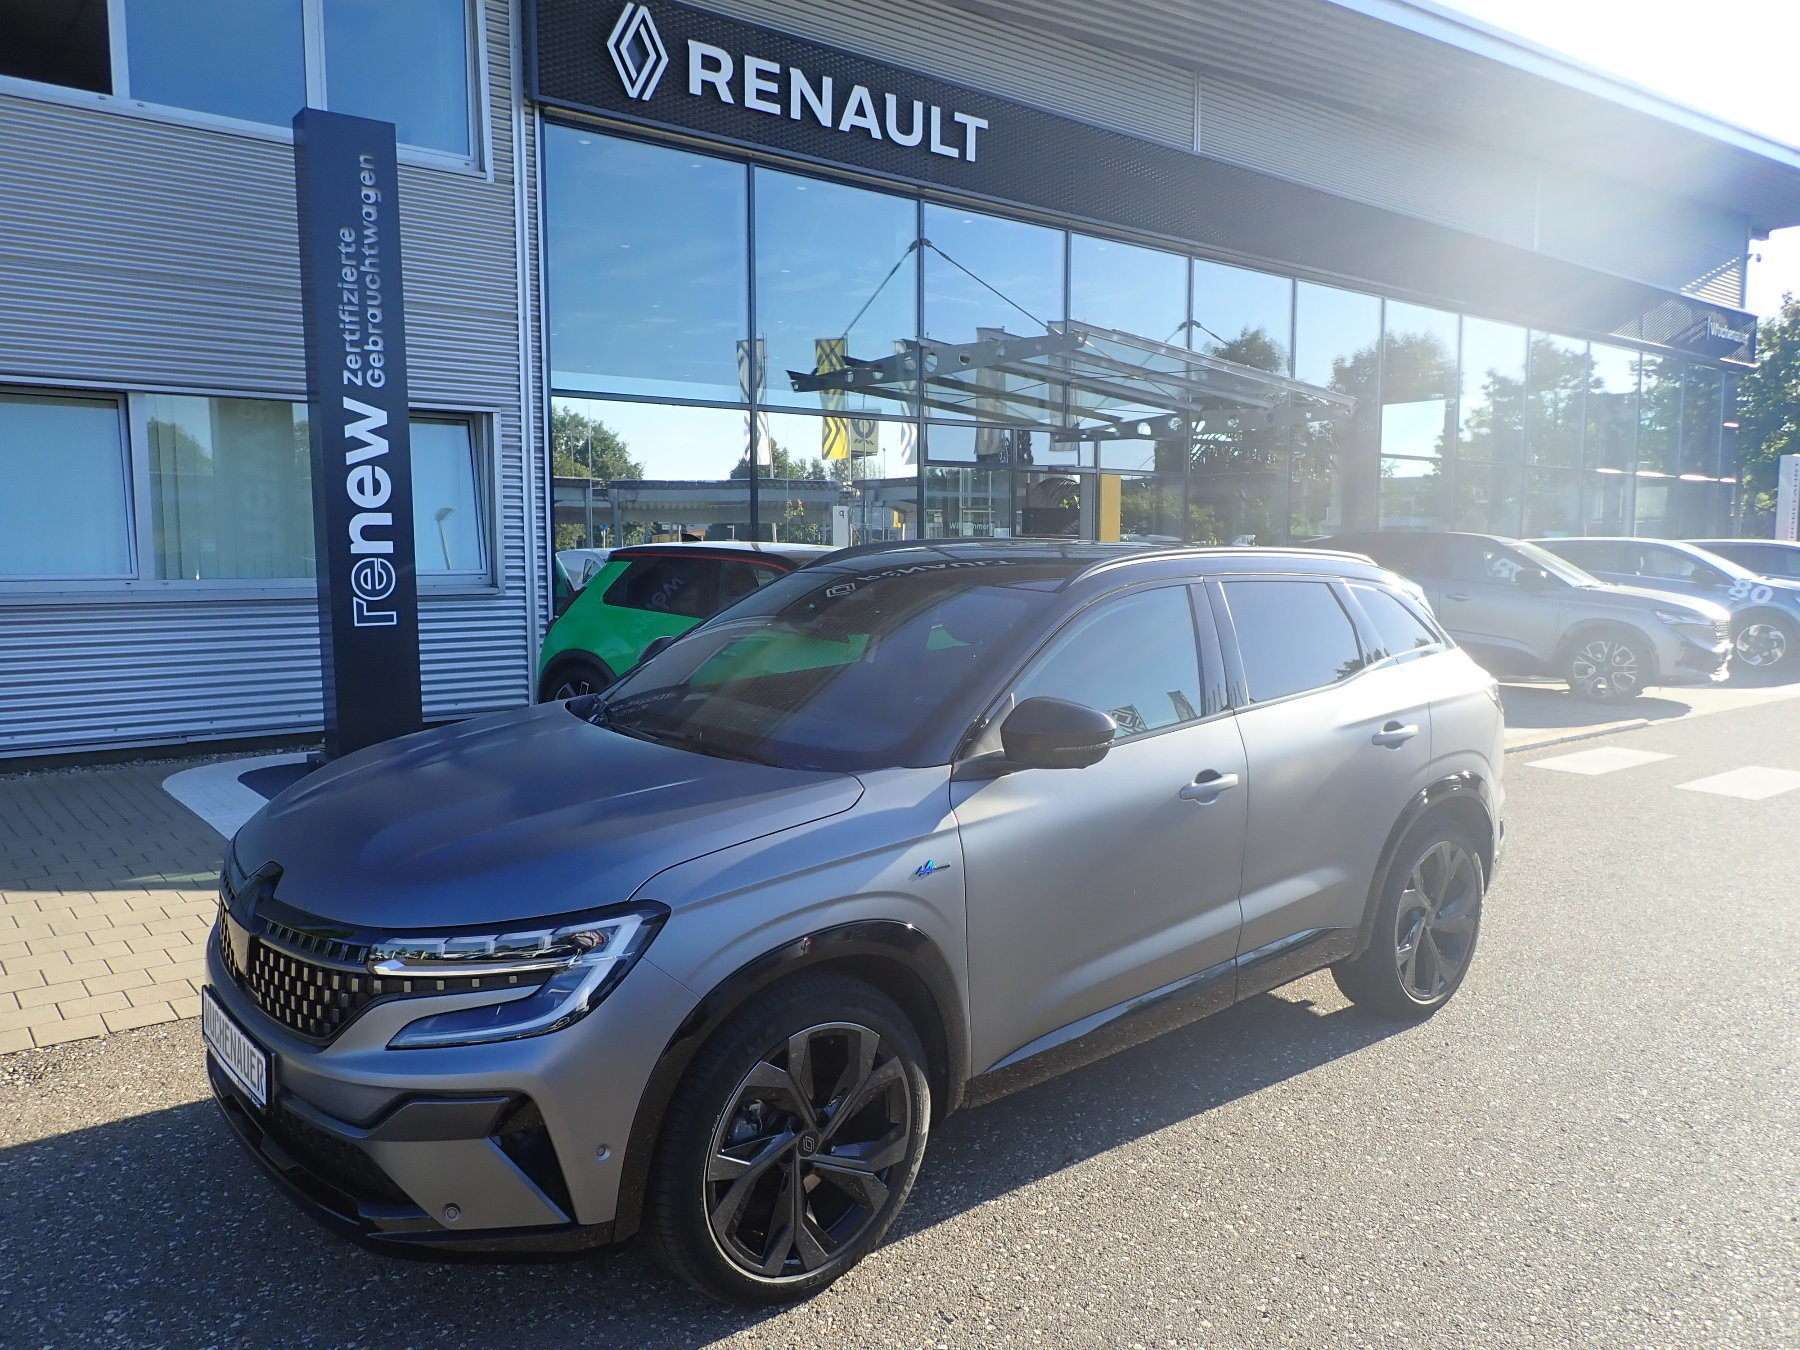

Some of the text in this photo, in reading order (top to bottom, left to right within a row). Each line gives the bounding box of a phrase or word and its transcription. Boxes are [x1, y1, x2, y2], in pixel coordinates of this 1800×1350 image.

[687, 39, 989, 163] RENAULT
[337, 225, 364, 386] Zertifizierte
[359, 153, 385, 389] Gebrauchtwagen
[345, 396, 398, 628] renew
